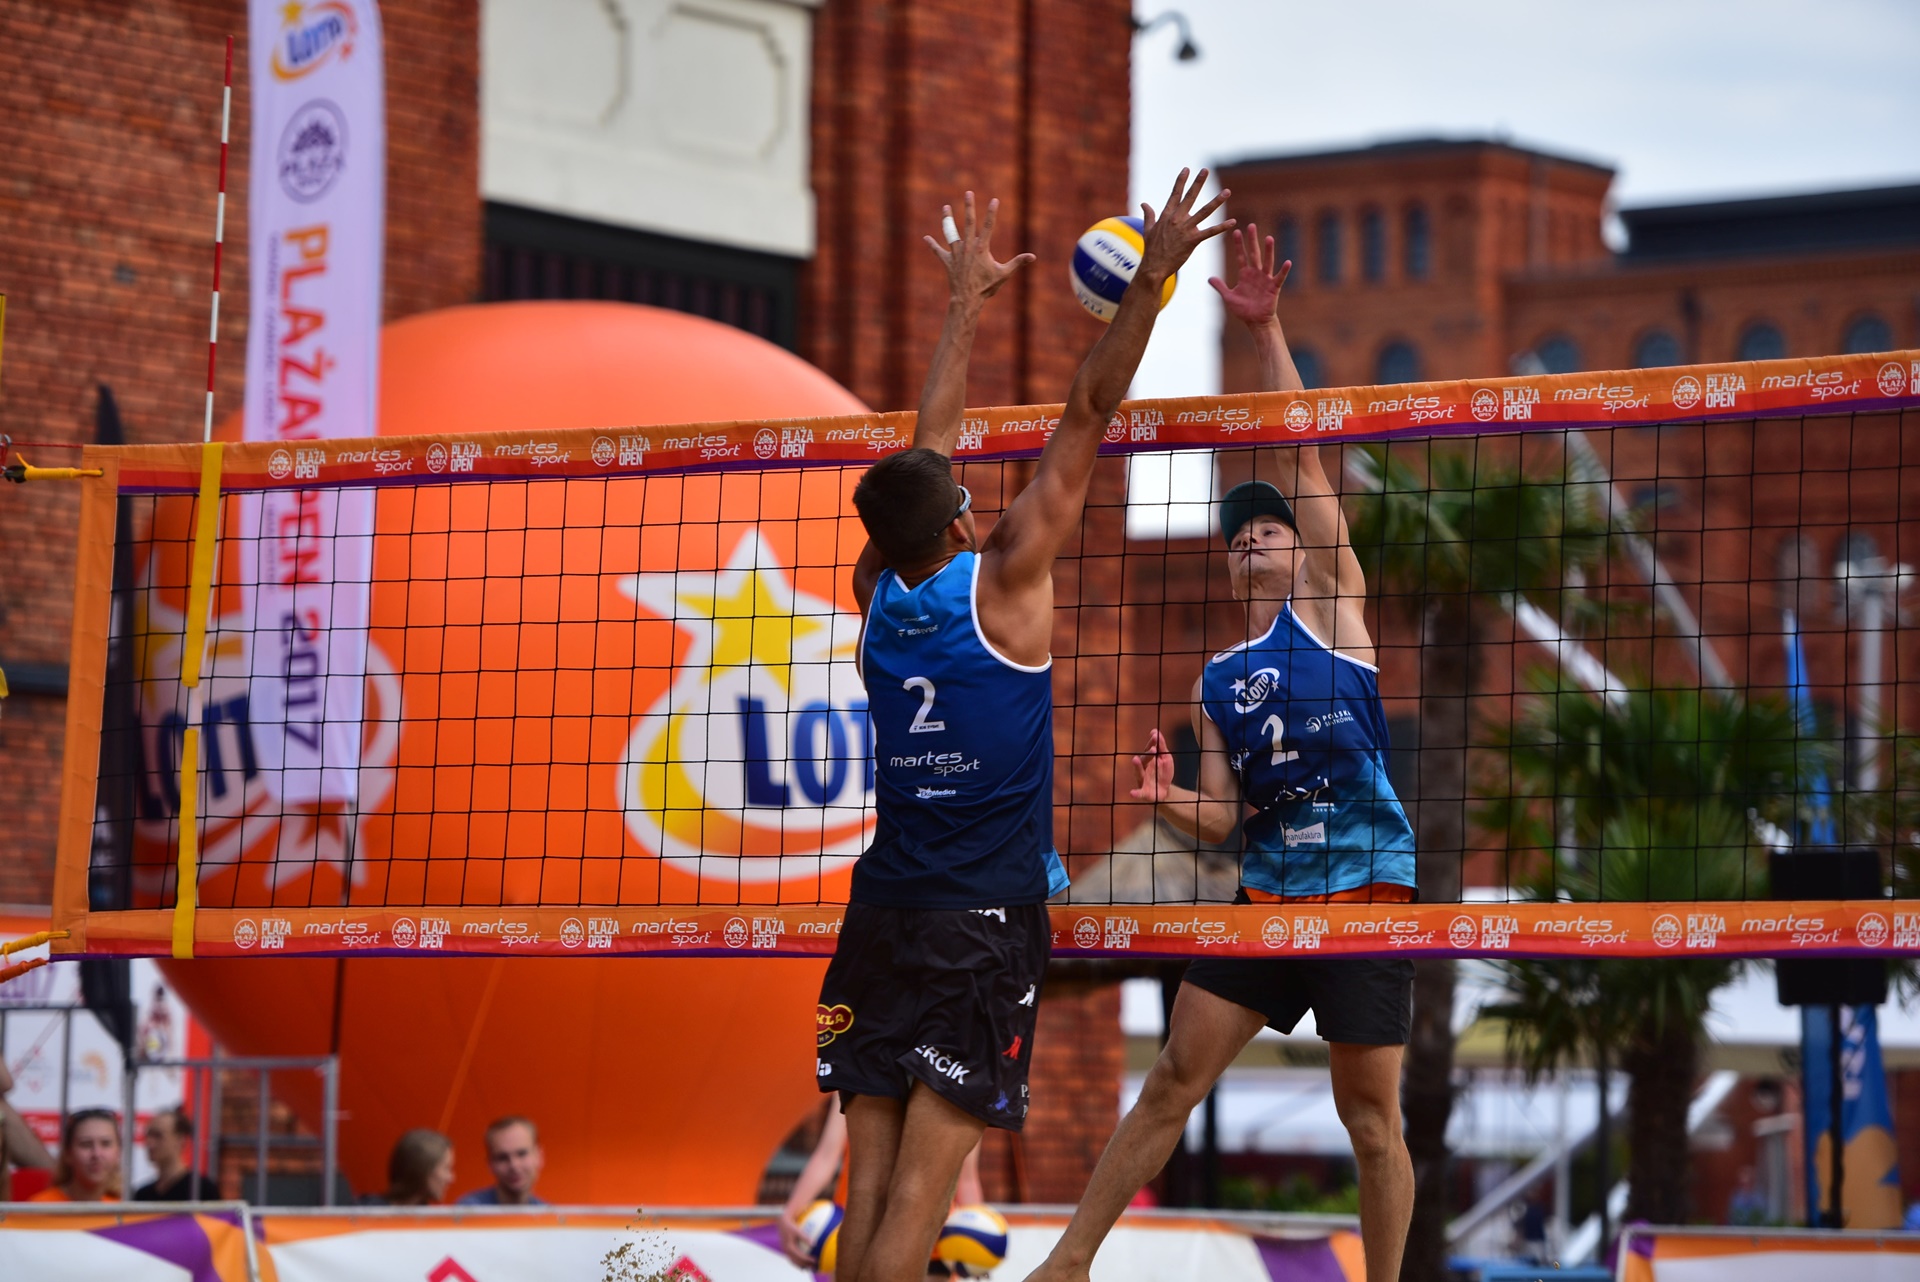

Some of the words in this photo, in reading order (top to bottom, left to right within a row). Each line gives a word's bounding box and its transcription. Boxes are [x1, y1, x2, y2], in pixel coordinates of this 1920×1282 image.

[1706, 373, 1746, 392] PLAŻA
[1761, 368, 1844, 390] martes
[1502, 386, 1540, 405] PLAŻA
[1554, 383, 1634, 401] martes
[1810, 380, 1858, 400] sport
[1318, 398, 1352, 415] PLAŻA
[1368, 394, 1440, 413] martes
[1602, 394, 1648, 414] sport
[1706, 391, 1736, 408] OPEN
[1130, 408, 1164, 427] PLAŻA
[1176, 405, 1250, 424] martes
[1409, 405, 1454, 424] sport
[1503, 404, 1532, 420] OPEN
[1002, 414, 1060, 432] marte
[1220, 417, 1262, 434] sport
[1317, 415, 1343, 432] OPEN
[663, 432, 727, 450] martes
[781, 427, 814, 444] PLAŻA
[826, 424, 896, 441] martes
[1130, 426, 1156, 442] OPEN
[451, 441, 482, 458] PLAŻA
[494, 440, 558, 456] martes
[620, 434, 650, 452] PLAŻA
[780, 444, 805, 458] OPEN
[866, 434, 906, 453] sport
[956, 435, 982, 450] OPEN
[296, 448, 326, 465] PLAŻA
[337, 447, 400, 464] martes
[530, 451, 570, 467] sport
[619, 452, 643, 466] OPEN
[700, 443, 739, 460] sport
[294, 465, 318, 479] OPEN
[374, 458, 412, 474] sport
[450, 458, 474, 472] OPEN
[281, 608, 320, 751] 2017
[1241, 673, 1269, 704] LOTTO
[903, 676, 946, 733] 2
[1260, 714, 1300, 766] 2
[890, 751, 963, 767] martes
[934, 759, 980, 777] sport
[261, 918, 292, 935] PLAŻA
[304, 919, 367, 934] martes
[420, 918, 451, 934] PLAŻA
[463, 918, 528, 934] martes
[588, 918, 620, 934] PLAŻA
[632, 918, 698, 934] martes
[752, 918, 785, 934] PLAŻA
[798, 917, 842, 934] mart
[1104, 917, 1140, 934] PLAŻA
[1153, 916, 1226, 934] martes
[1294, 916, 1329, 934] PLAŻA
[1344, 916, 1419, 933] martes
[1482, 915, 1518, 934] PLAŻA
[1534, 916, 1612, 932] martes
[1687, 914, 1726, 933] PLAŻA
[1741, 914, 1824, 932] martes
[260, 935, 284, 949] OPEN
[342, 931, 379, 946] sport
[419, 934, 443, 948] OPEN
[500, 932, 539, 947] sport
[588, 934, 612, 948] OPEN
[671, 930, 710, 947] sport
[752, 934, 776, 948] OPEN
[1104, 934, 1130, 948] OPEN
[1195, 930, 1238, 946] sport
[1293, 934, 1320, 948] OPEN
[1388, 930, 1432, 947] sport
[1481, 934, 1510, 948] OPEN
[1580, 930, 1627, 948] sport
[1686, 932, 1716, 948] OPEN
[1790, 927, 1839, 946] sport
[1893, 931, 1920, 948] OPE
